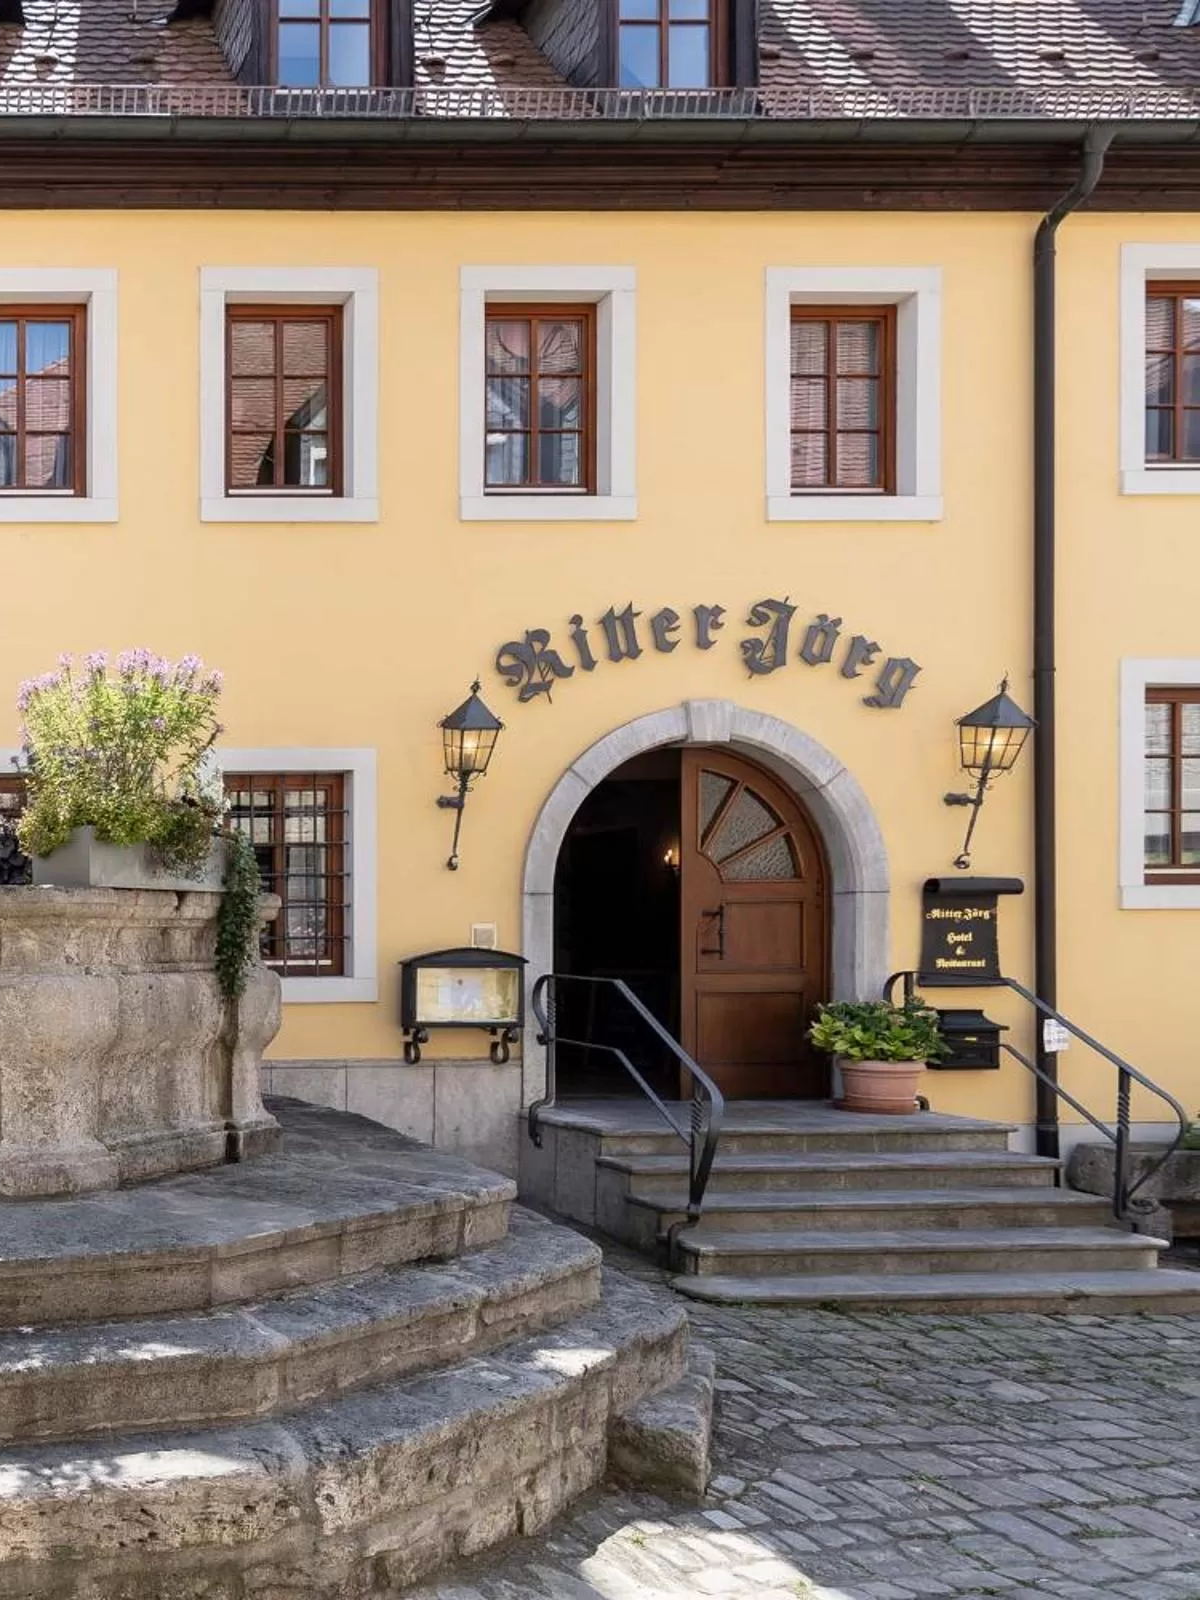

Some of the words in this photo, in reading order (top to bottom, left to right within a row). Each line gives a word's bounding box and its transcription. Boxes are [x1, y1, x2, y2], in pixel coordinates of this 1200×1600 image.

[496, 601, 727, 704] Ritter
[739, 596, 922, 709] Jörg
[946, 932, 973, 944] Hotel
[955, 945, 966, 955] &
[935, 958, 986, 968] Restaurant
